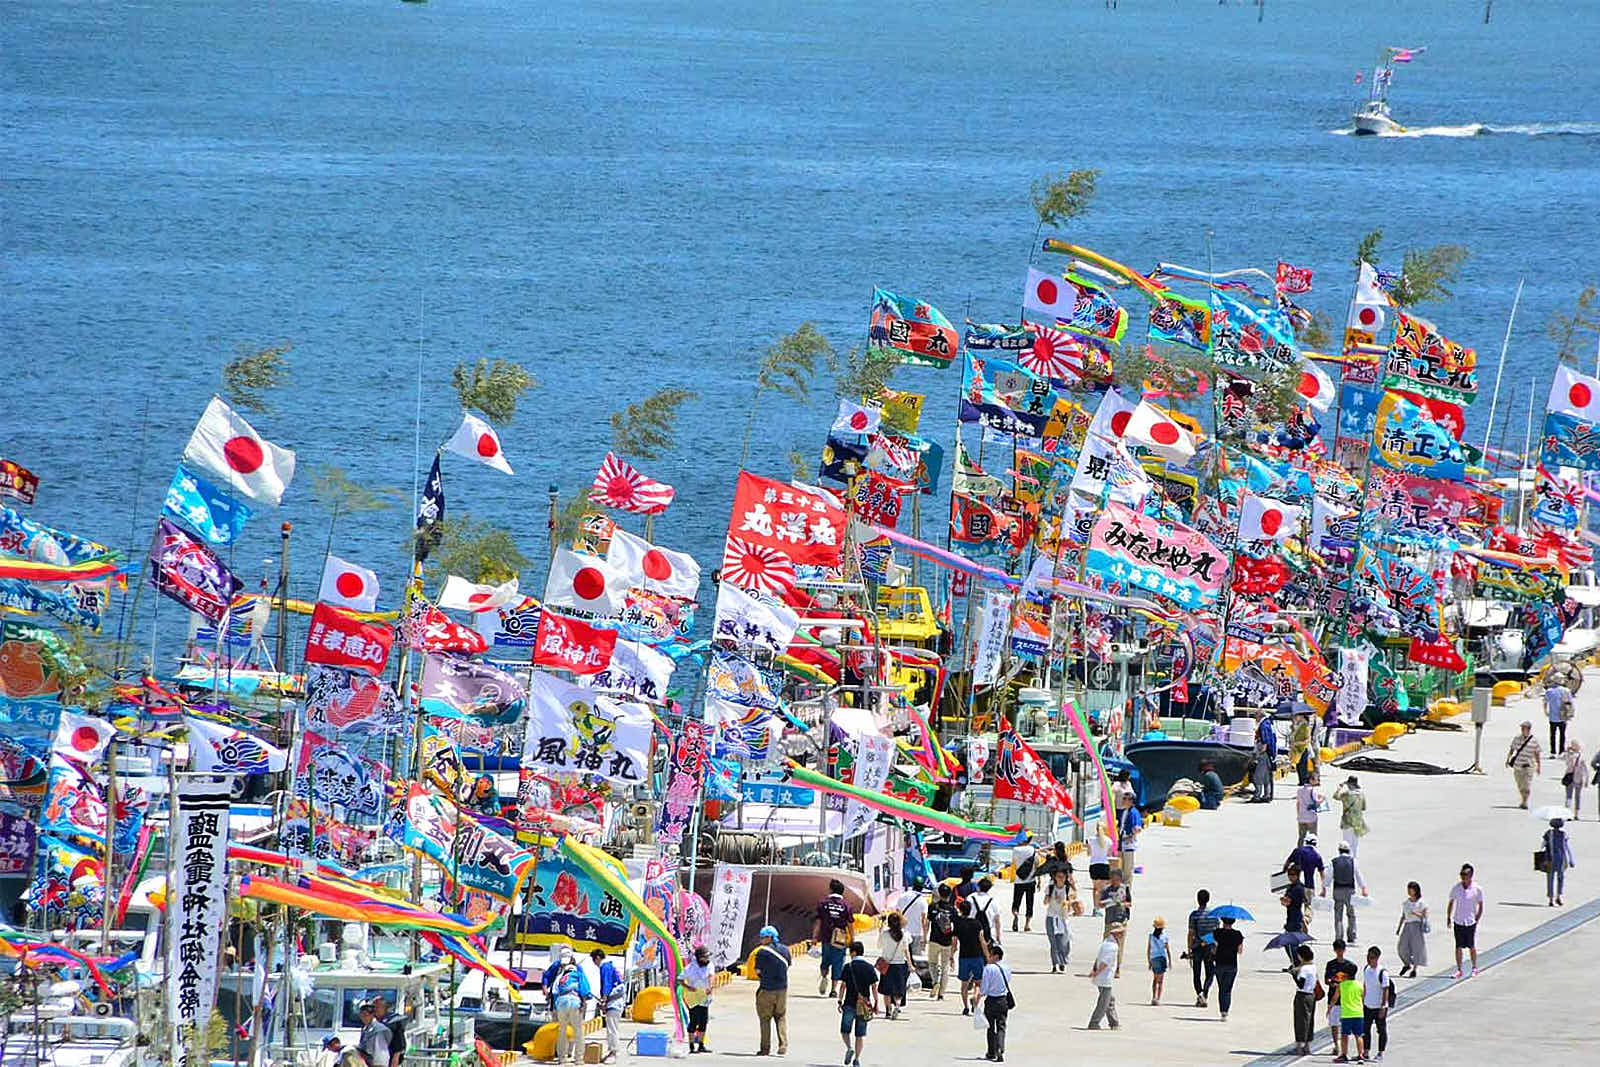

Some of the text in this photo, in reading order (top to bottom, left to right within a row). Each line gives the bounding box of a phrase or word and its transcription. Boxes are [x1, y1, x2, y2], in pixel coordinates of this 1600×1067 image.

[764, 487, 828, 513] 第三十五
[533, 736, 637, 781] 風神丸
